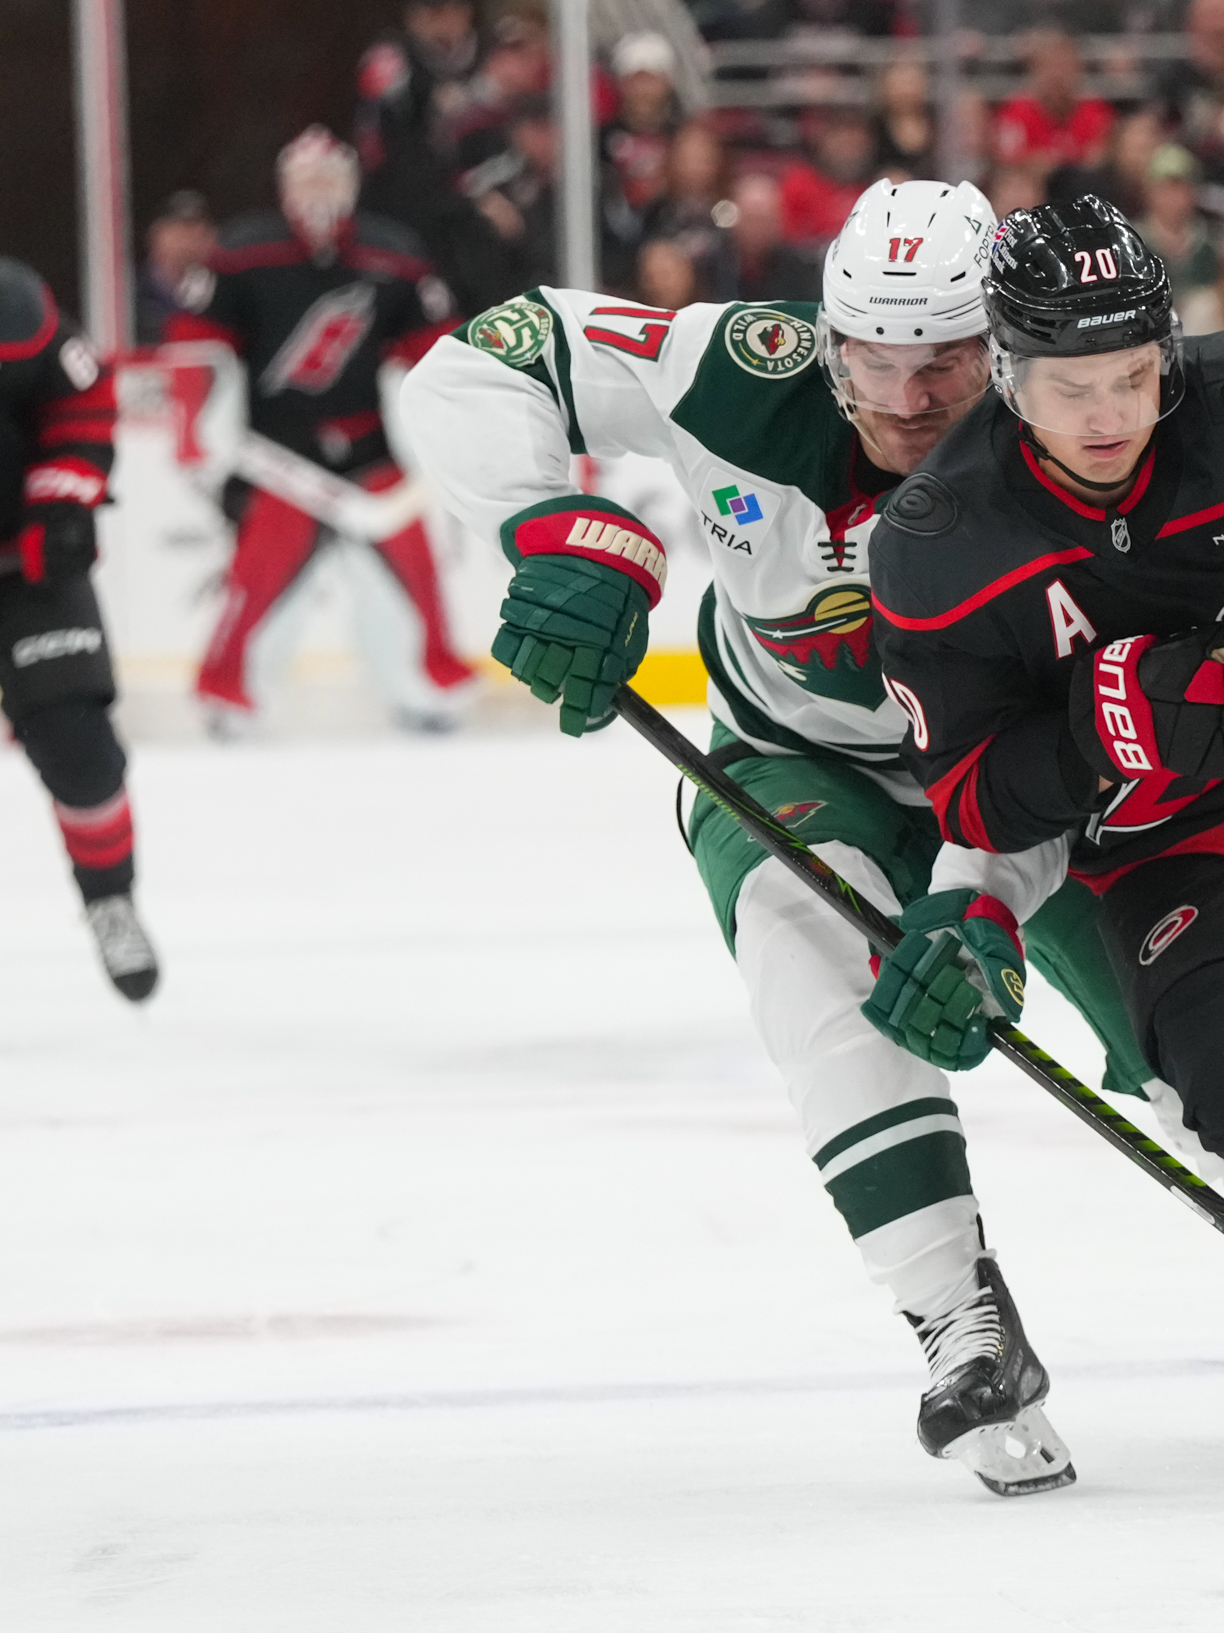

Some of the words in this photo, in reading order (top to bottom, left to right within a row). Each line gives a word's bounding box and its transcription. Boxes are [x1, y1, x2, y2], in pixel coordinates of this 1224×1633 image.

[888, 237, 923, 262] 17
[1073, 248, 1118, 284] 20
[869, 296, 928, 306] WARRIOR
[1077, 309, 1136, 329] BAUER
[583, 306, 677, 363] 17
[732, 313, 758, 341] WILD
[766, 321, 813, 372] MINNESOTA
[701, 510, 753, 556] TRIA
[1045, 578, 1098, 660] A
